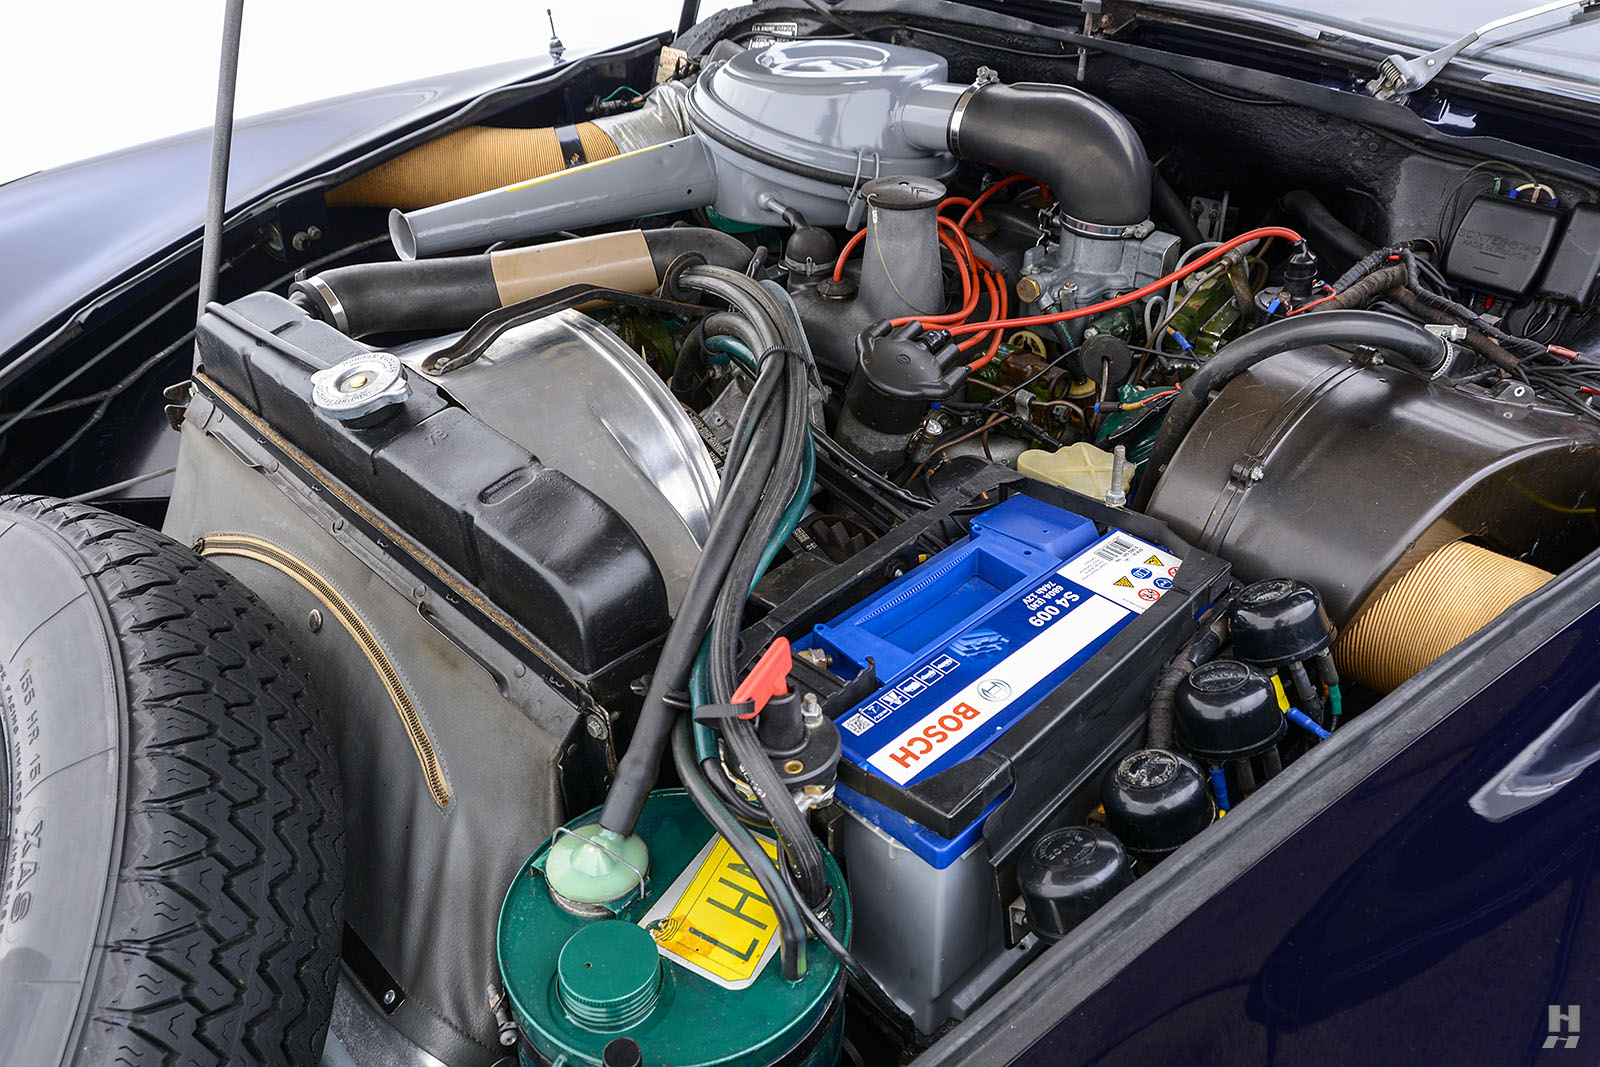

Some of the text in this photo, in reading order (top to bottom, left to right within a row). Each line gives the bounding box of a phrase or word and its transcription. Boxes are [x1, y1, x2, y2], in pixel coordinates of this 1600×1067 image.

[1023, 581, 1056, 605] 74Ah 12V
[1027, 585, 1064, 611] 680A (EN)
[1028, 591, 1080, 627] S4 009
[20, 669, 41, 782] 155 HR 15
[888, 702, 981, 769] BOSCH
[11, 819, 43, 924] XAS
